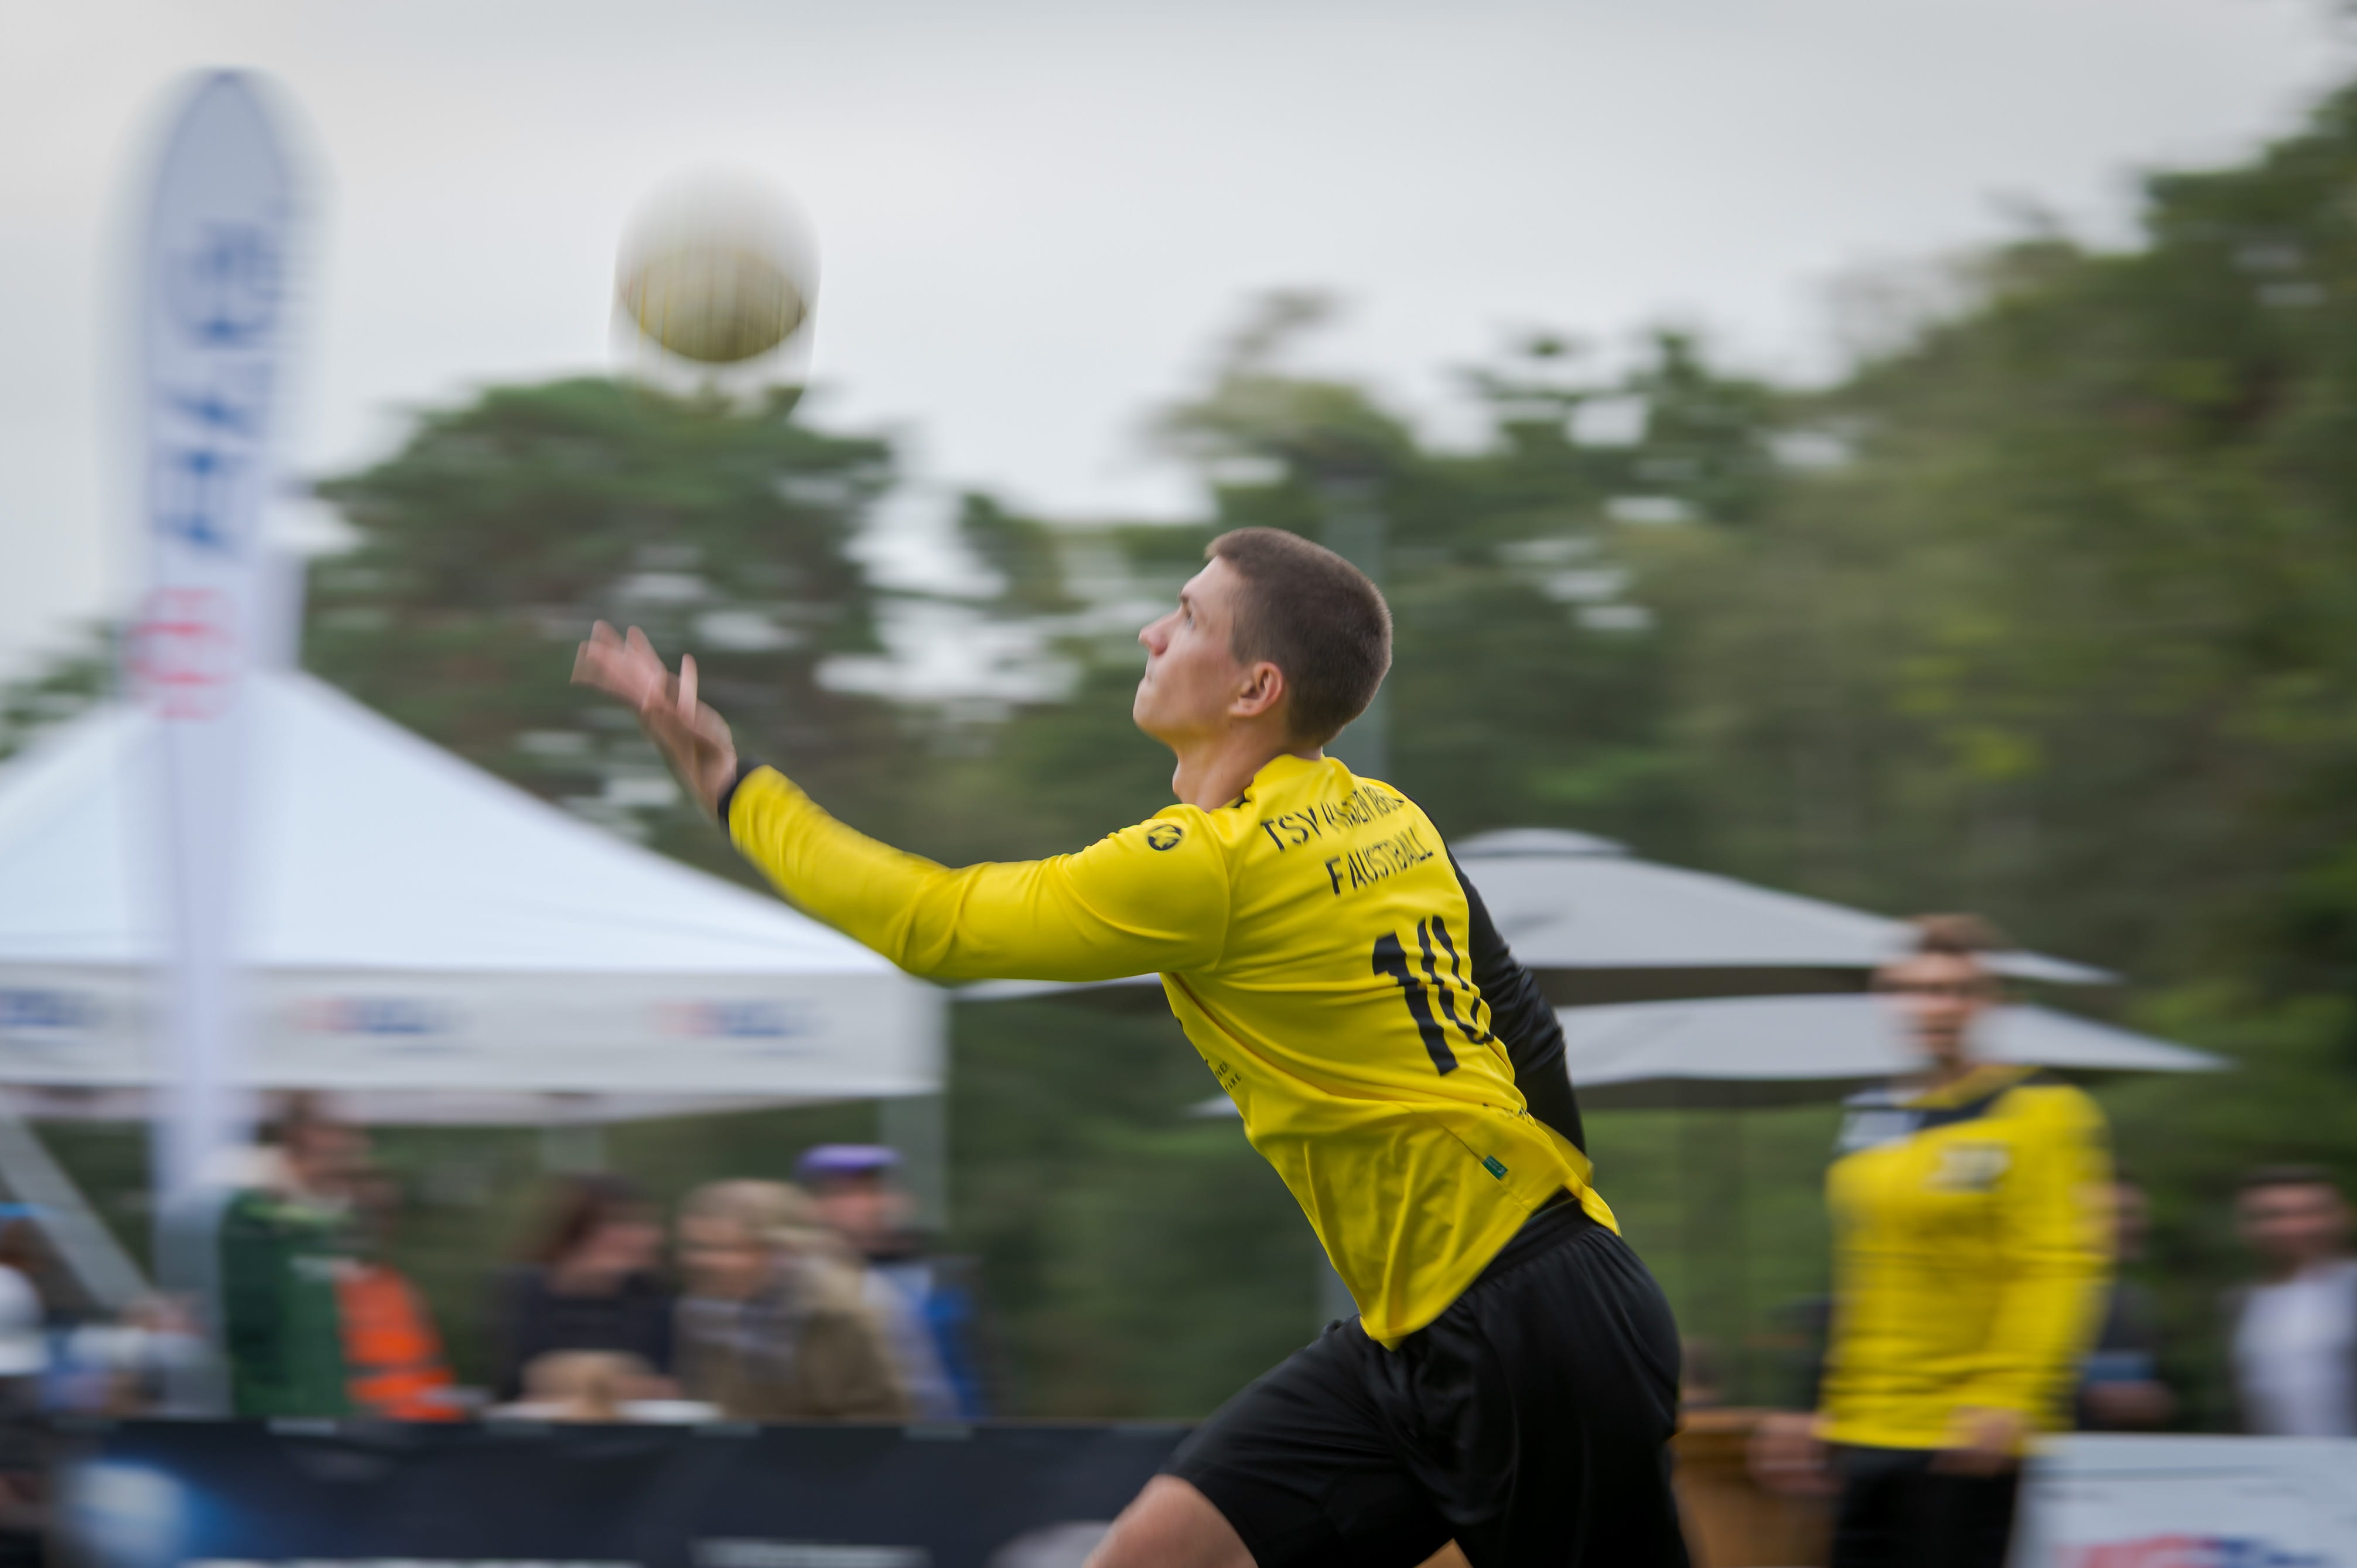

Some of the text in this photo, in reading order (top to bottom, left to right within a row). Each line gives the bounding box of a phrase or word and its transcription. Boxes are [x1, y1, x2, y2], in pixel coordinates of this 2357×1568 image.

[1261, 804, 1322, 852] TSV
[1324, 826, 1434, 897] FAUSTBALL
[1372, 914, 1495, 1077] 10
